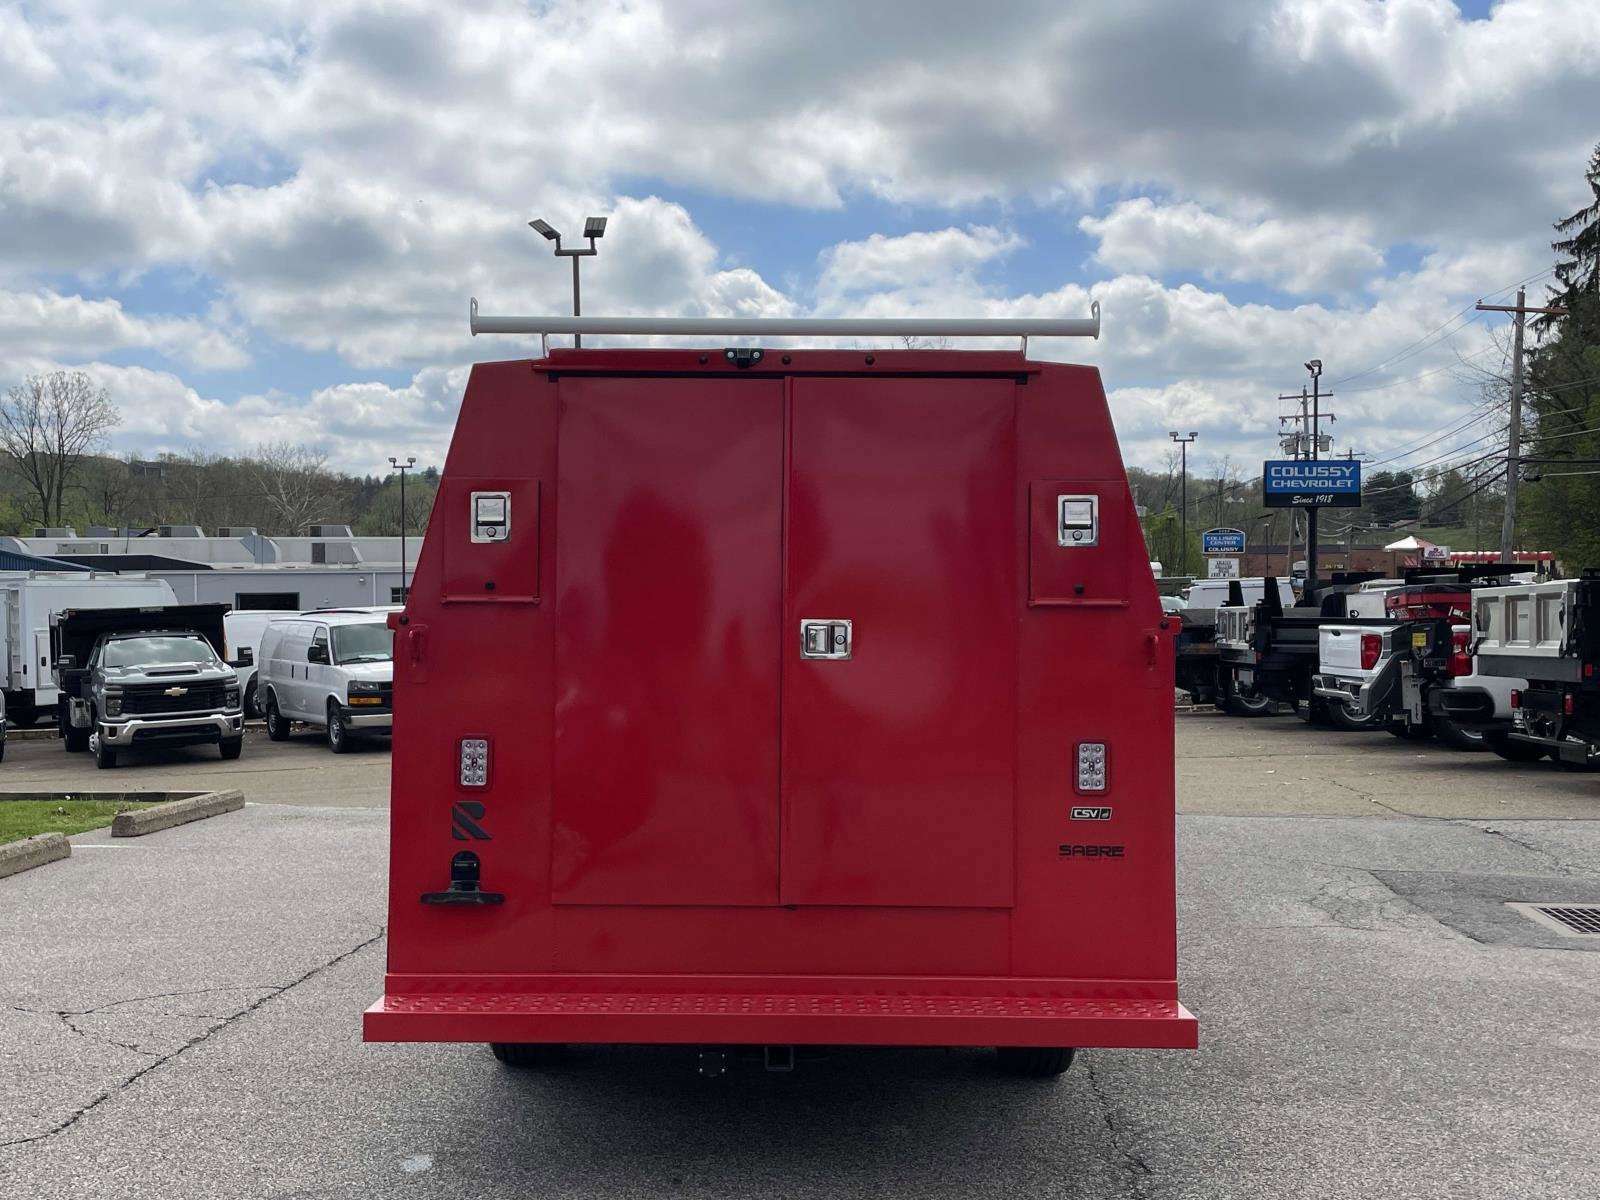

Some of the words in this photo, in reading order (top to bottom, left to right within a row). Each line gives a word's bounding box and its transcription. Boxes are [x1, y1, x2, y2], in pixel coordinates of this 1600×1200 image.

[1271, 466, 1354, 476] COLUSSY
[1272, 479, 1354, 488] CHEVROLET
[1291, 495, 1313, 504] Since
[1315, 494, 1334, 503] 1918
[1073, 809, 1098, 817] CSV
[1059, 845, 1125, 857] SABRE
